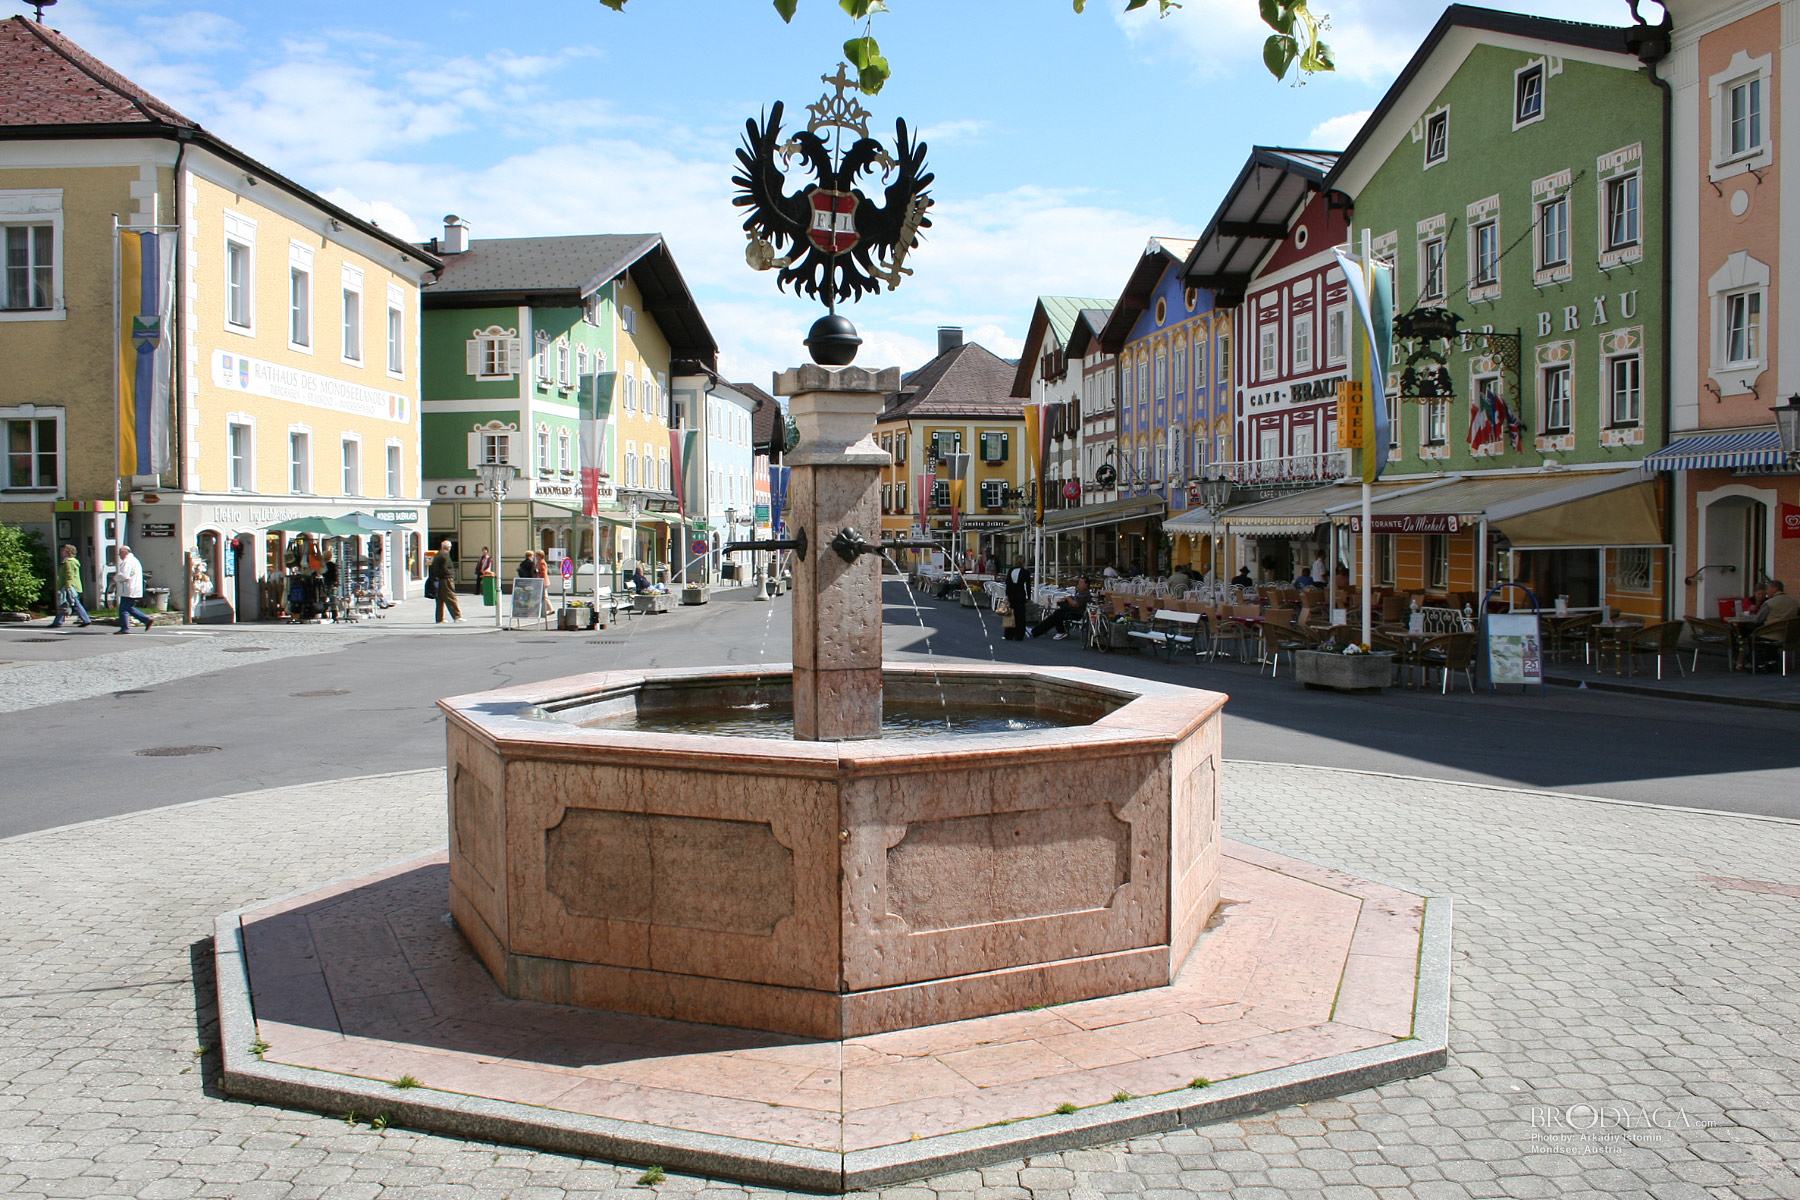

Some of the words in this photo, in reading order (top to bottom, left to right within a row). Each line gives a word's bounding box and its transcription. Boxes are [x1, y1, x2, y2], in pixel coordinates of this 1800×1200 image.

[1536, 290, 1638, 337] BRÄU
[254, 364, 298, 387] RATHAUS
[301, 375, 317, 391] DES
[320, 382, 386, 406] MONDSEELANDES
[1352, 382, 1363, 439] HOTEL
[437, 483, 485, 498] caf
[1361, 520, 1402, 528] TORANTE
[1402, 516, 1414, 532] Da
[1415, 515, 1446, 531] Michele
